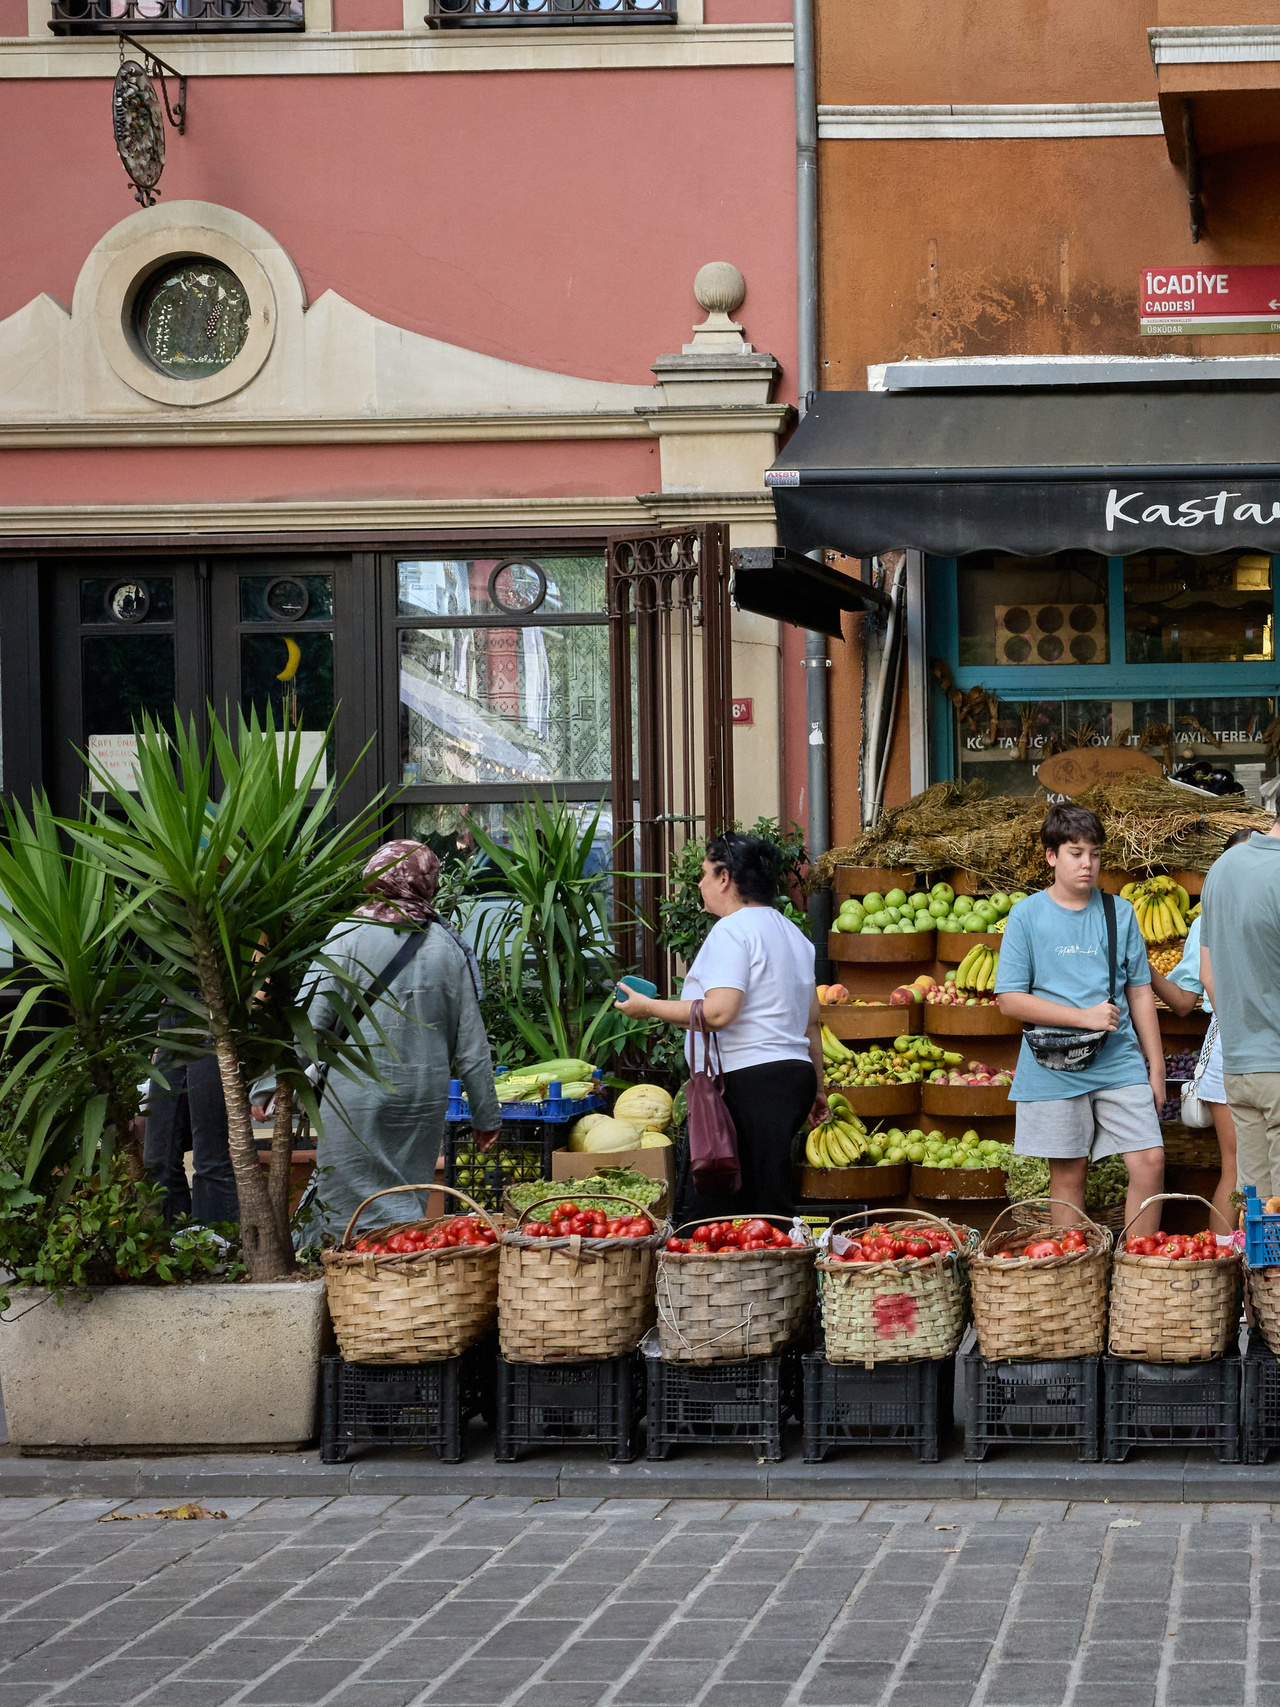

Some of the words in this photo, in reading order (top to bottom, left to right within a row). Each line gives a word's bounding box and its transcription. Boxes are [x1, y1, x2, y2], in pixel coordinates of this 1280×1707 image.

[1146, 271, 1229, 295] İCADİYE
[1145, 299, 1195, 312] CADDESİ
[1147, 325, 1183, 334] ÜSKÜDAR
[1068, 1045, 1090, 1059] NIKE
